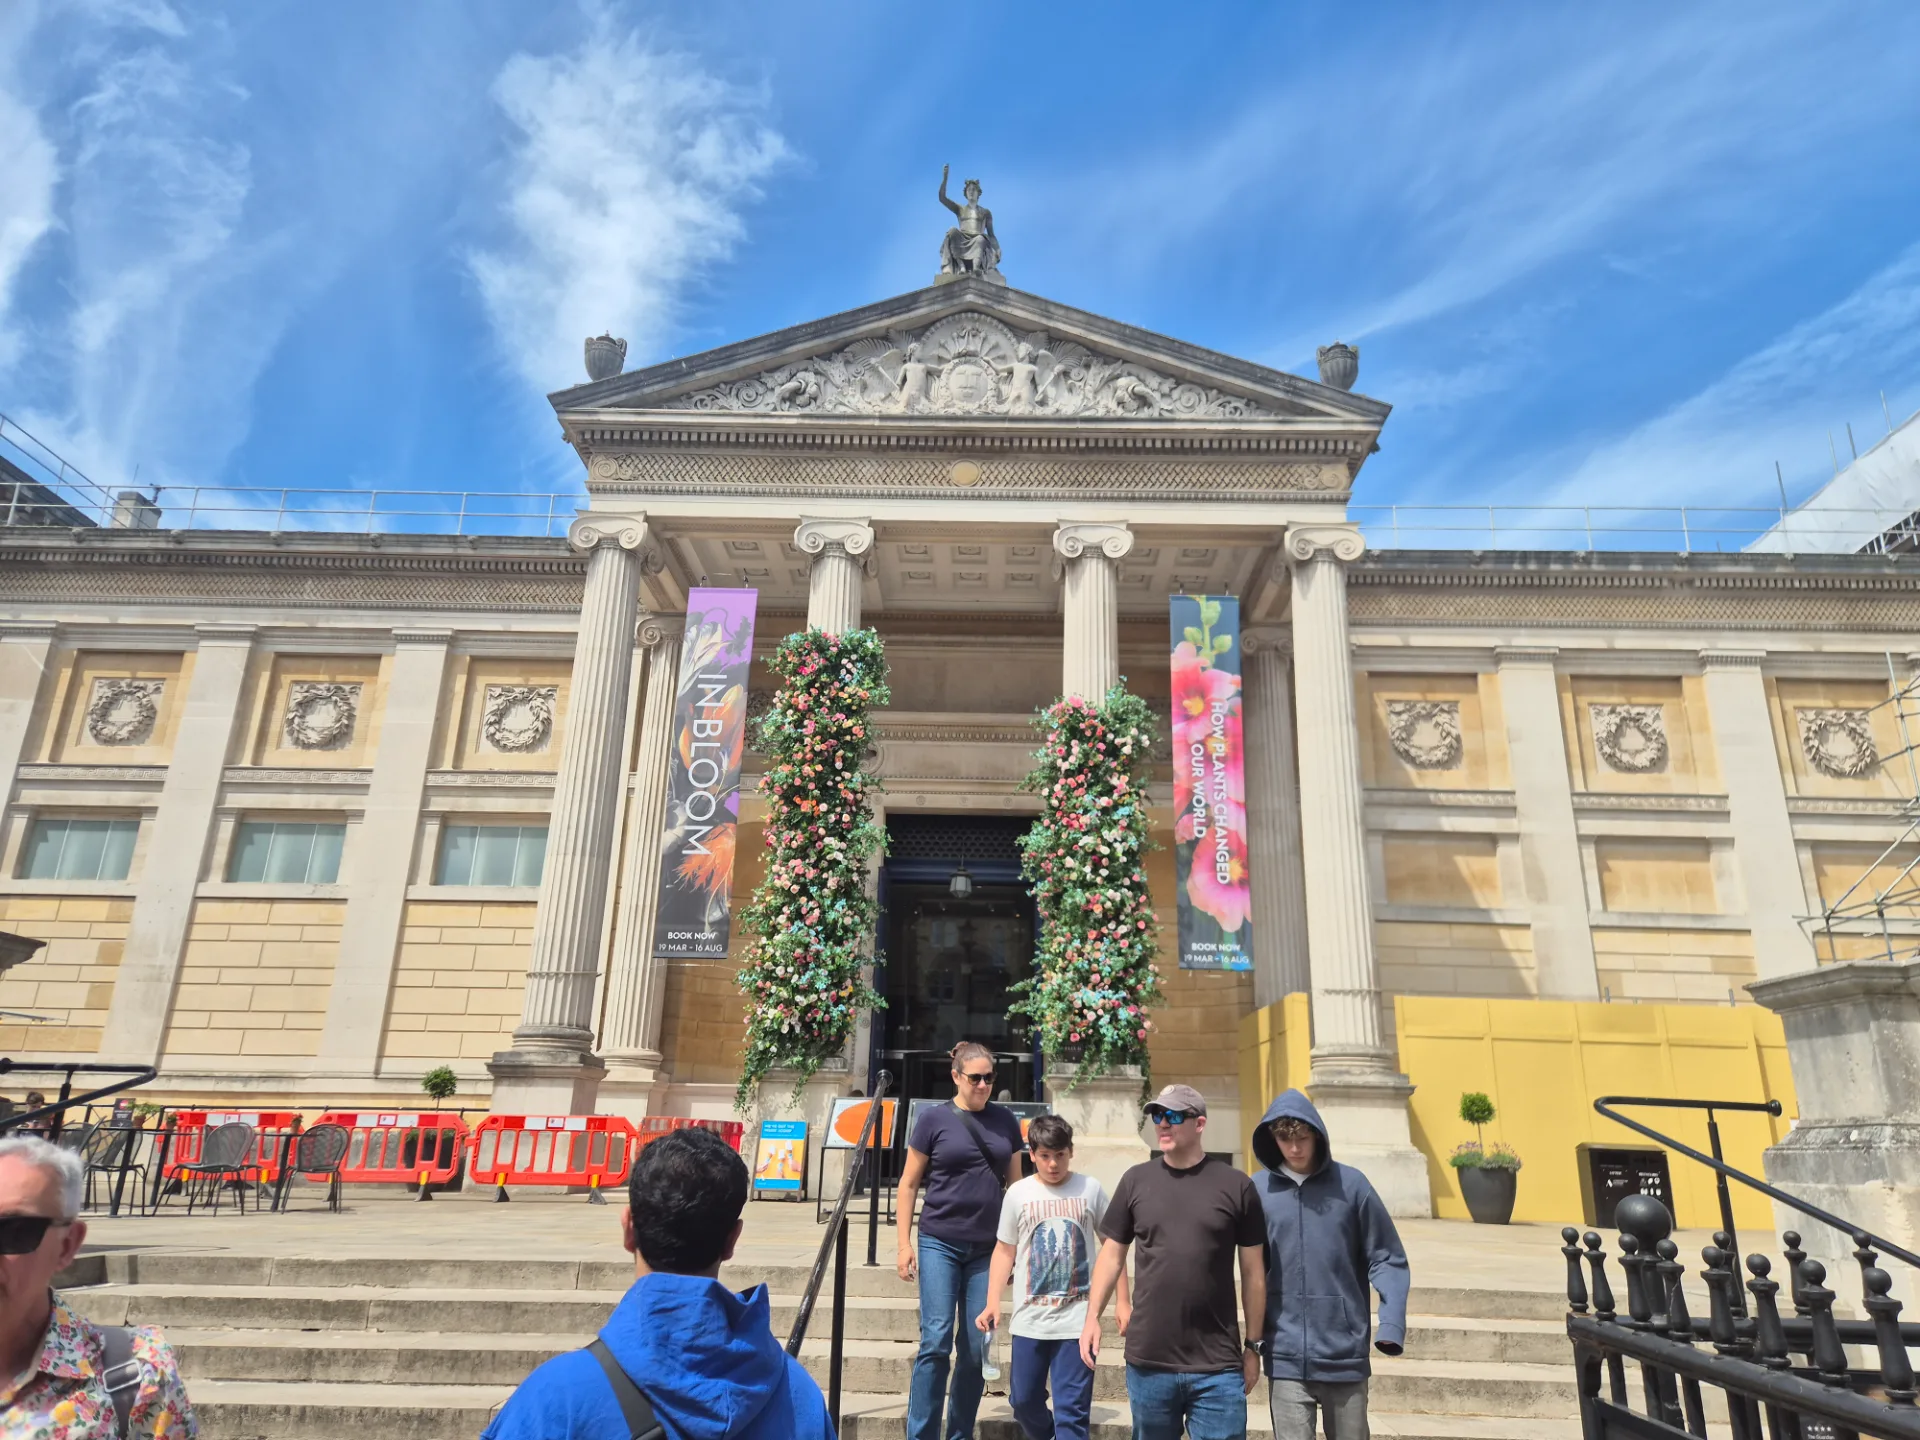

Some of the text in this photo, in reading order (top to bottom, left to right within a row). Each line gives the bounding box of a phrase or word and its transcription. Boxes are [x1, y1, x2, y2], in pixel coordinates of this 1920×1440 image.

[682, 674, 727, 855] IN BLOOM
[1191, 743, 1207, 839] OUR WORLD
[1211, 701, 1230, 885] HOW PLANTS CHANGED
[667, 931, 716, 940] BOOK NOW
[658, 943, 667, 951] 19
[668, 944, 687, 952] MAR
[695, 944, 703, 952] 16
[704, 944, 723, 952] AUG
[1191, 942, 1241, 952] BOOK NOW
[1184, 953, 1193, 962] 19
[1193, 954, 1213, 962] MAR
[1221, 955, 1230, 963] 16
[1230, 955, 1249, 964] AUG
